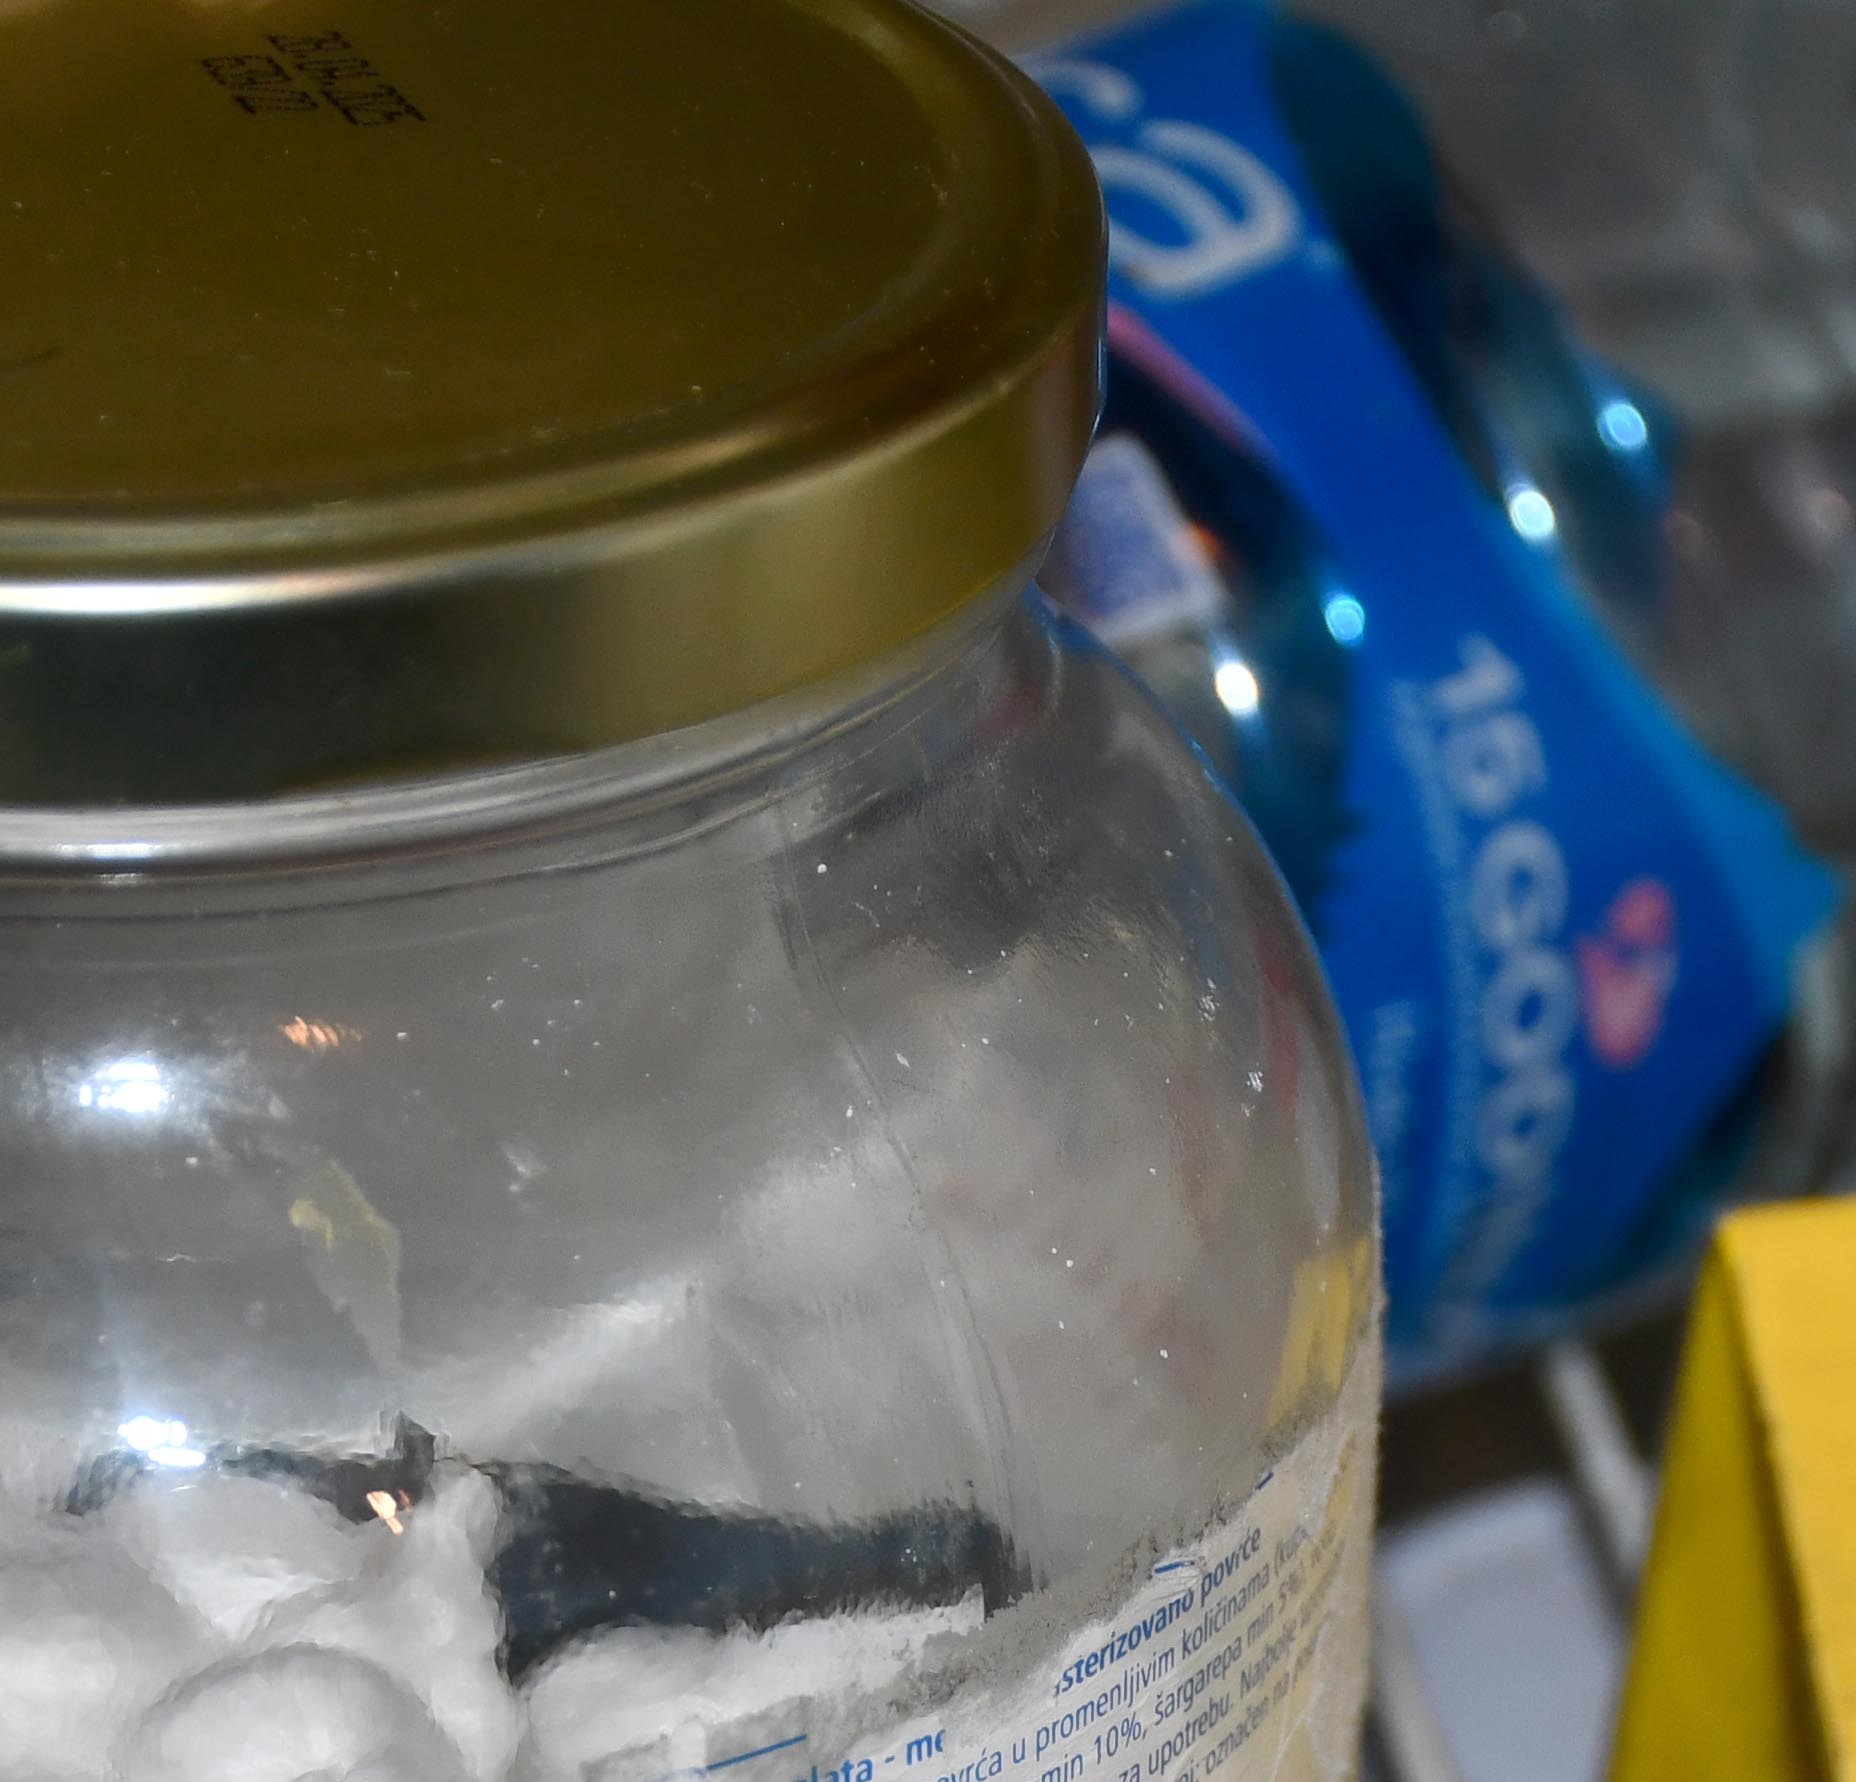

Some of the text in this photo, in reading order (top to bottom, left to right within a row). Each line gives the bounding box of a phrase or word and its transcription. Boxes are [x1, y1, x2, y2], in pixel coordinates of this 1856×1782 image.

[1442, 632, 1546, 818] 15
[1012, 1737, 1026, 1764] u
[1035, 1649, 1174, 1755] promenljivim
[1182, 1571, 1270, 1662] količinama
[1054, 1588, 1193, 1695] sterizovano
[1201, 1526, 1261, 1607] povrće
[1095, 1712, 1147, 1765] 10%,
[1154, 1640, 1242, 1726] šargarepa
[1247, 1598, 1274, 1652] min
[1149, 1695, 1232, 1773] upotrebu.
